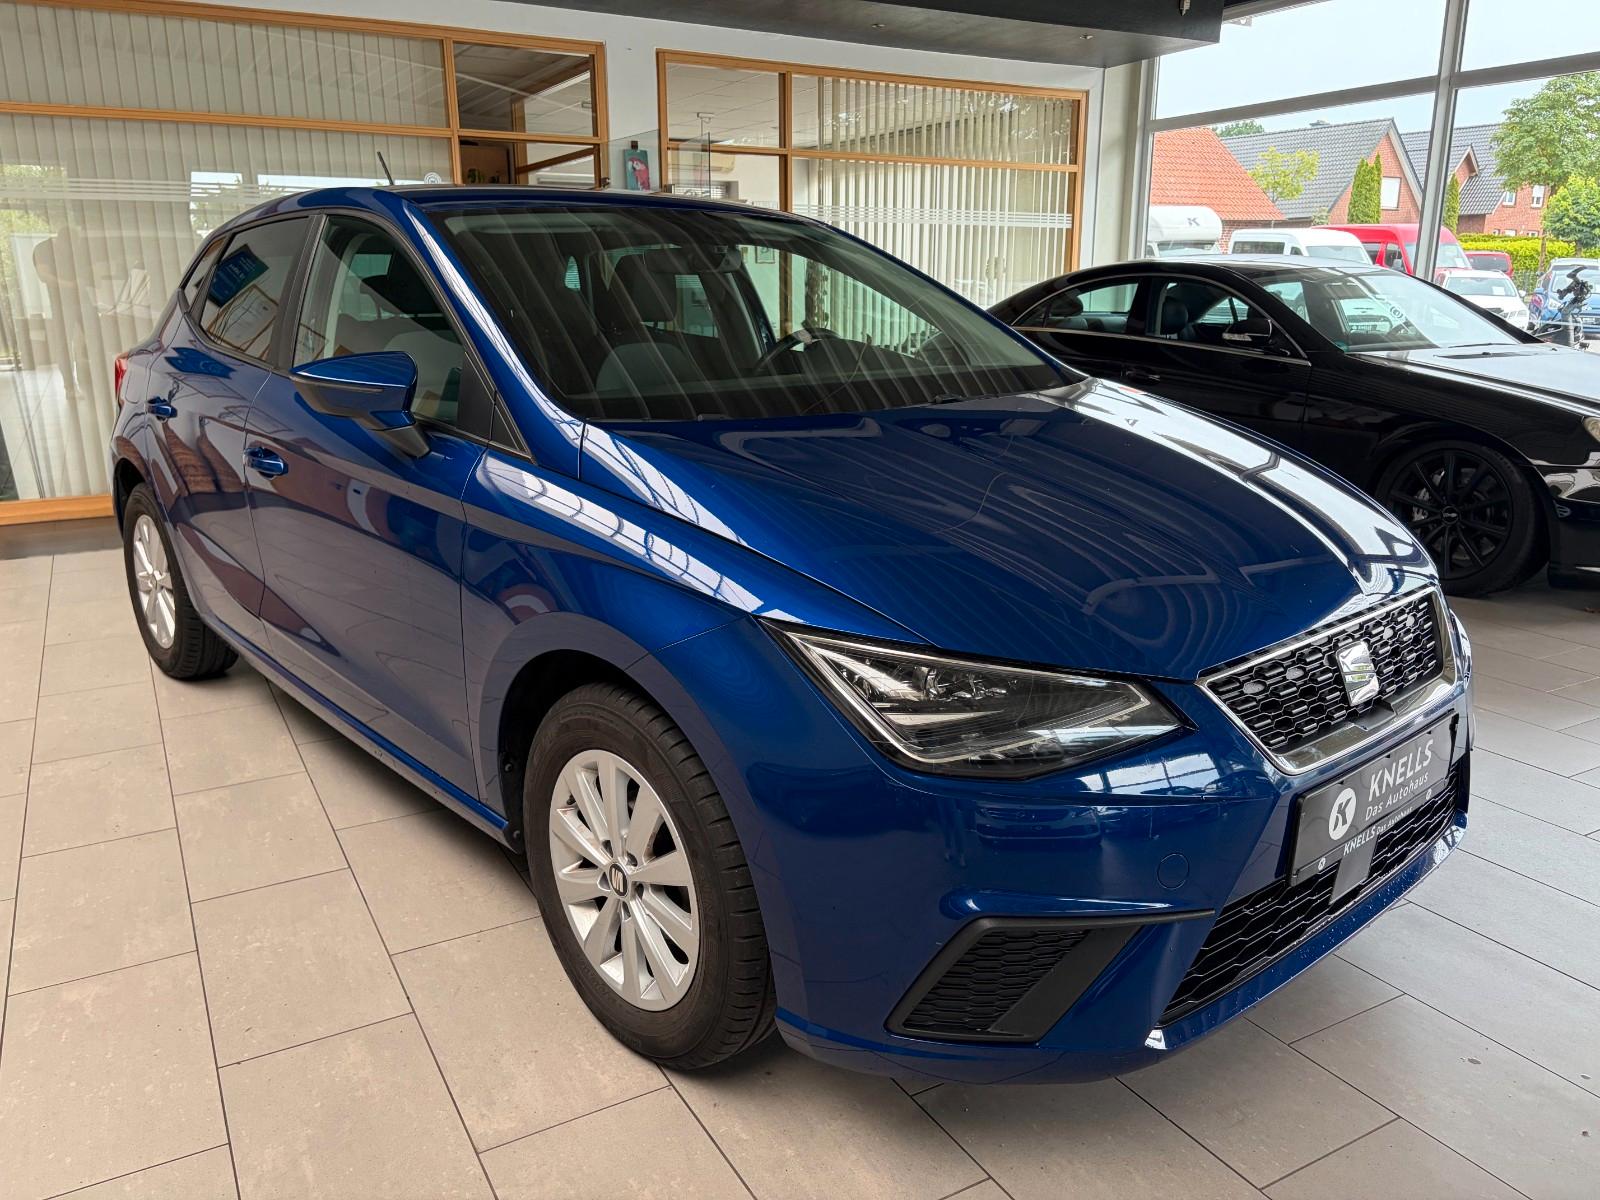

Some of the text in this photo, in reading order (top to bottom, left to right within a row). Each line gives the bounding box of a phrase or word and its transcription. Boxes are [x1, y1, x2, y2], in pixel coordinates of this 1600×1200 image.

[1369, 740, 1433, 801] KNELLS
[1365, 803, 1383, 821] Das
[1386, 771, 1428, 807] Autohaus
[1343, 824, 1377, 857] KNELLS
